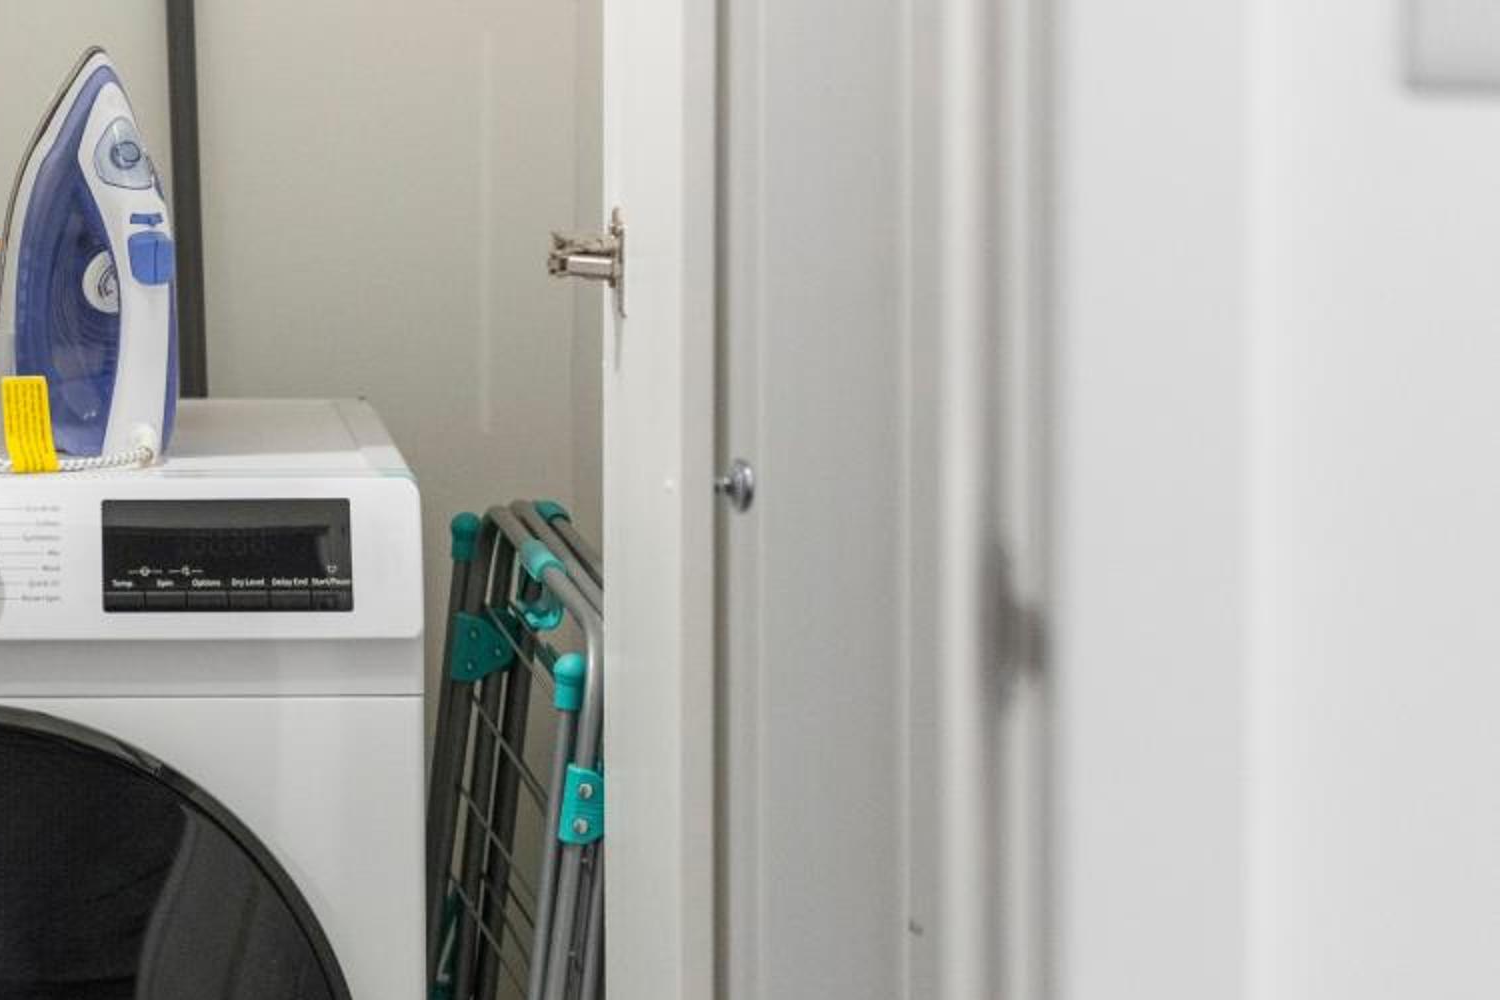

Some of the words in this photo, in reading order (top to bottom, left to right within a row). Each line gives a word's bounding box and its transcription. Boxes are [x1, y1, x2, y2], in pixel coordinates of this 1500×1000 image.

[191, 577, 221, 588] Options
[231, 577, 245, 588] Dry
[245, 577, 265, 587] Level
[271, 577, 293, 588] Delay
[293, 577, 309, 587] End
